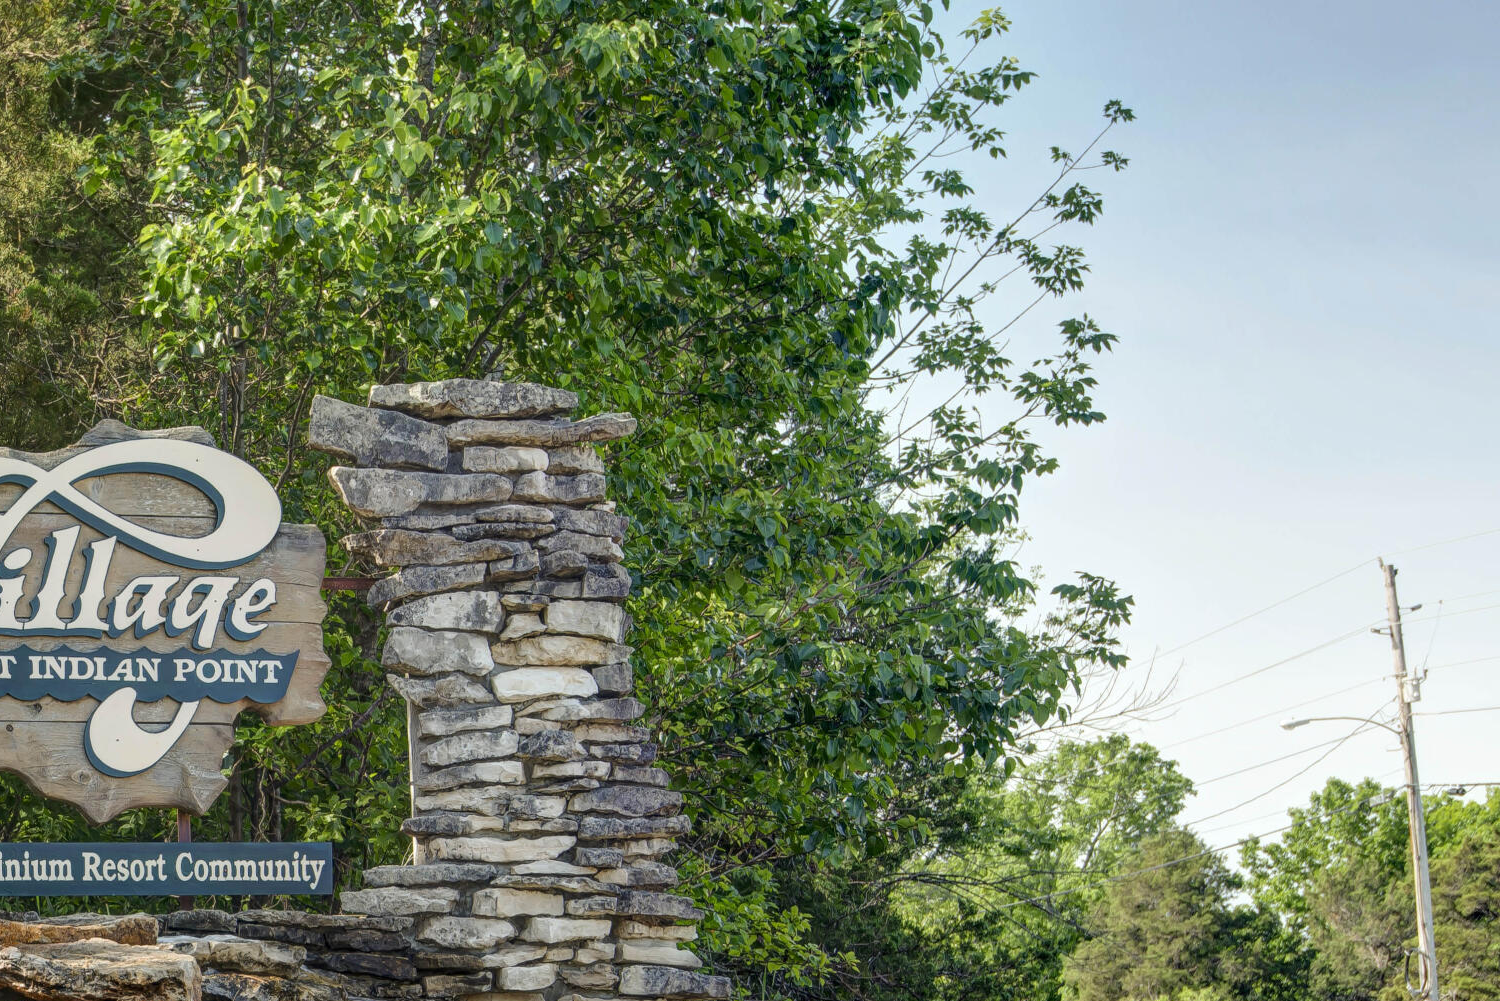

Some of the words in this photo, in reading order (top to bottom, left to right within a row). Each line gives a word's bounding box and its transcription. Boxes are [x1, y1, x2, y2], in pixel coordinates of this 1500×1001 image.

[28, 655, 160, 683] INDIAN
[173, 657, 283, 685] POINT
[81, 852, 167, 882] Resort
[175, 851, 326, 890] Community
